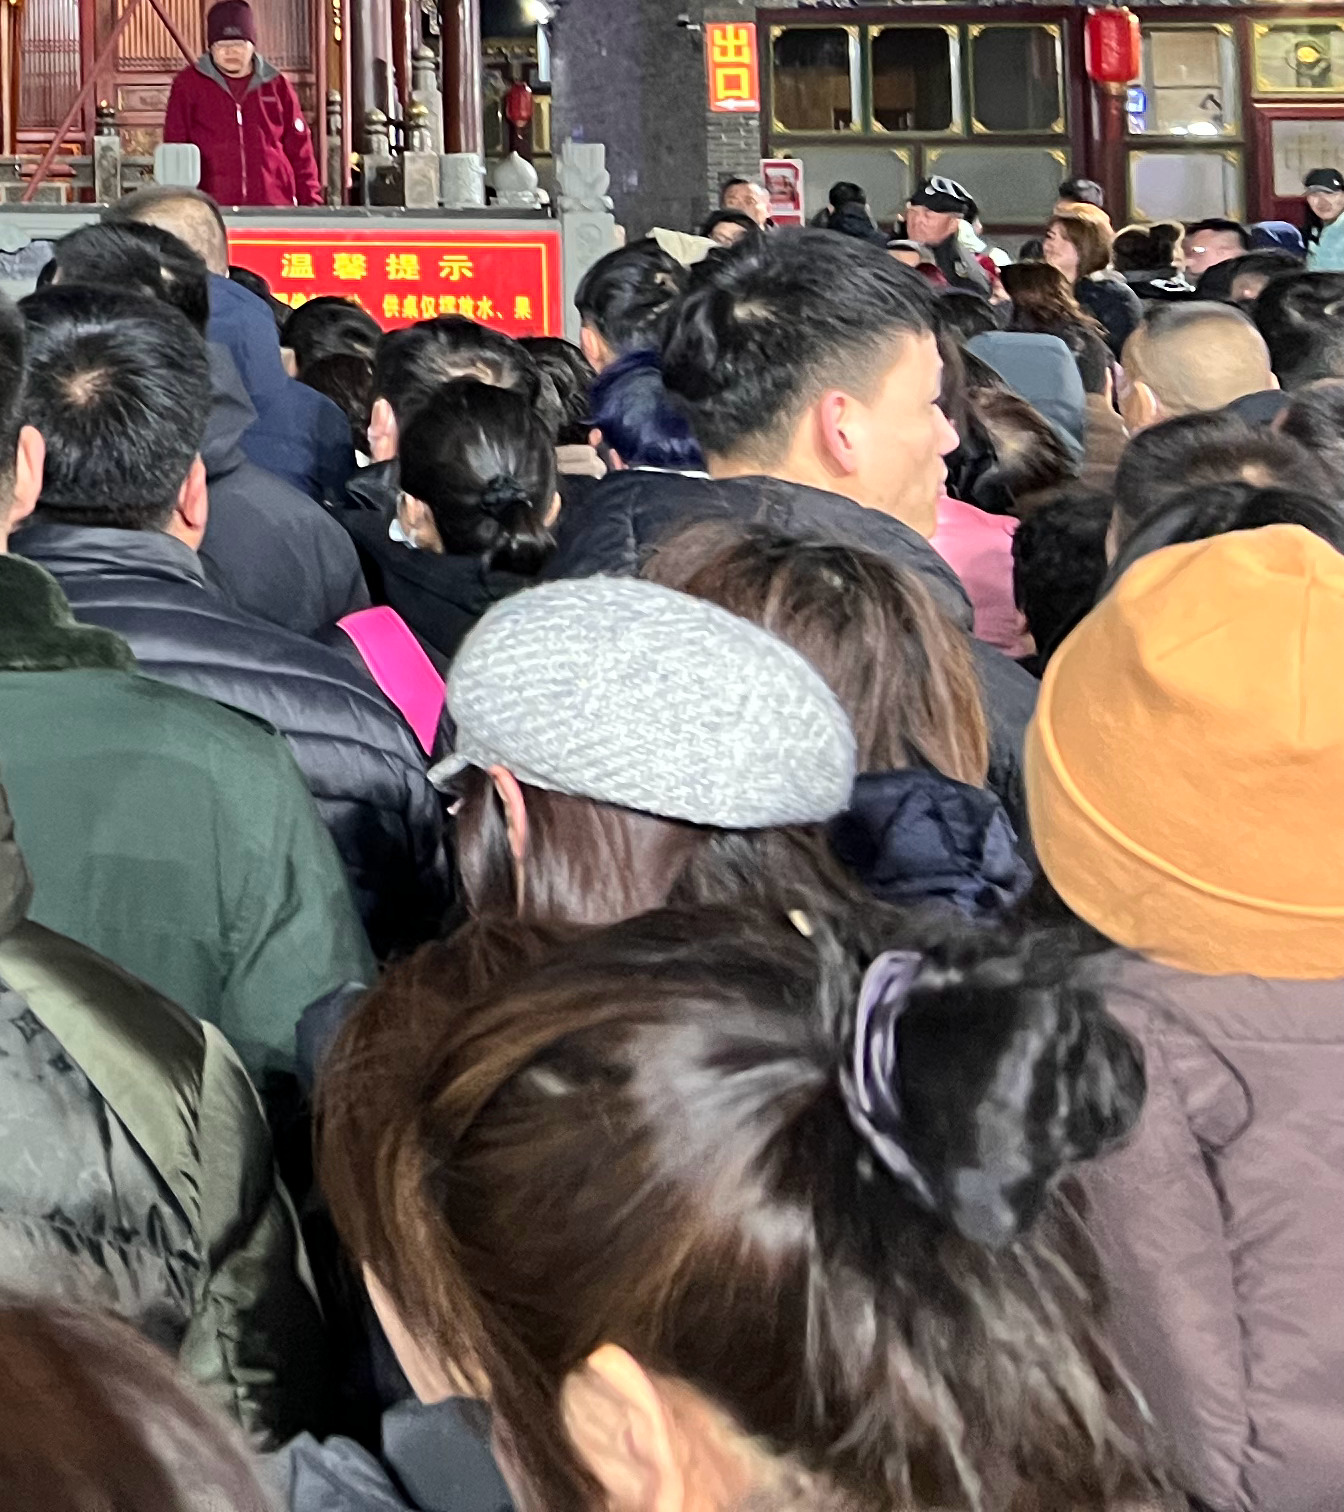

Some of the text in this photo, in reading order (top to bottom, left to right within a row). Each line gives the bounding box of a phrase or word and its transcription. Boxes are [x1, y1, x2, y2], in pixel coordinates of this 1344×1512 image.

[713, 24, 751, 100] 出口
[280, 253, 474, 281] 温馨提示
